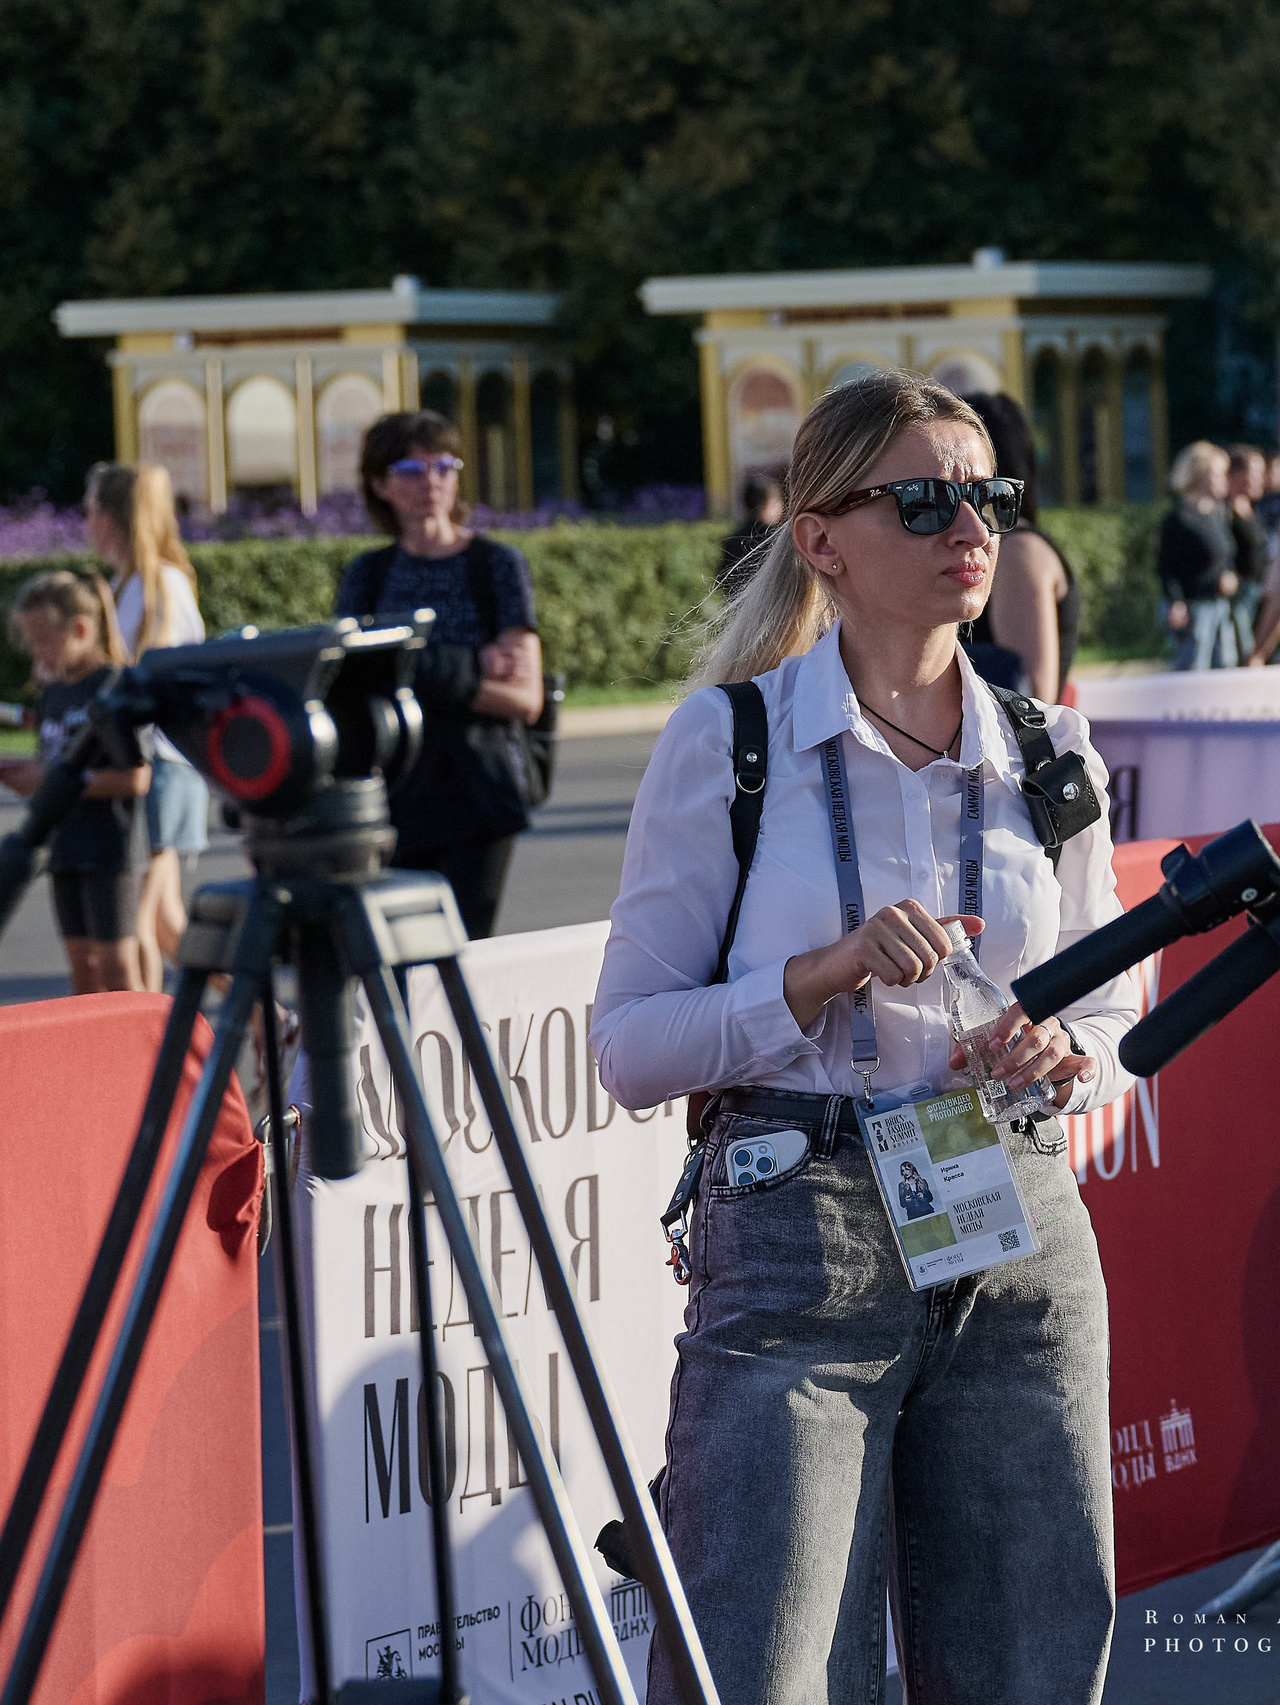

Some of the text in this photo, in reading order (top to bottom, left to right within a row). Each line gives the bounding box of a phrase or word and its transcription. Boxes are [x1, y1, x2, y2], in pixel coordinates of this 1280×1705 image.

[825, 740, 852, 862] МОСКОВСКАЯ НЕДЕЛЯ МОДЫ
[967, 783, 980, 820] САММИТ
[964, 859, 979, 916] ДЕЛЯ МОДЫ
[846, 903, 860, 933] САММ
[853, 986, 868, 1015] РИКС+
[926, 1093, 971, 1114] ФОТО/ВИДЕО
[929, 1102, 974, 1122] PHOTO/VIDEO
[887, 1120, 915, 1135] FASHION
[890, 1128, 916, 1143] SUMMIT
[952, 1191, 1002, 1214] МОСКОВСКАЯ
[956, 1208, 985, 1225] НЕДЕЛЯ
[959, 1220, 984, 1236] МОДЫ
[417, 1606, 501, 1640] ПРАВТЕЛЬСТВО
[520, 1593, 575, 1638] ФОН
[418, 1636, 465, 1661] МОСЫ
